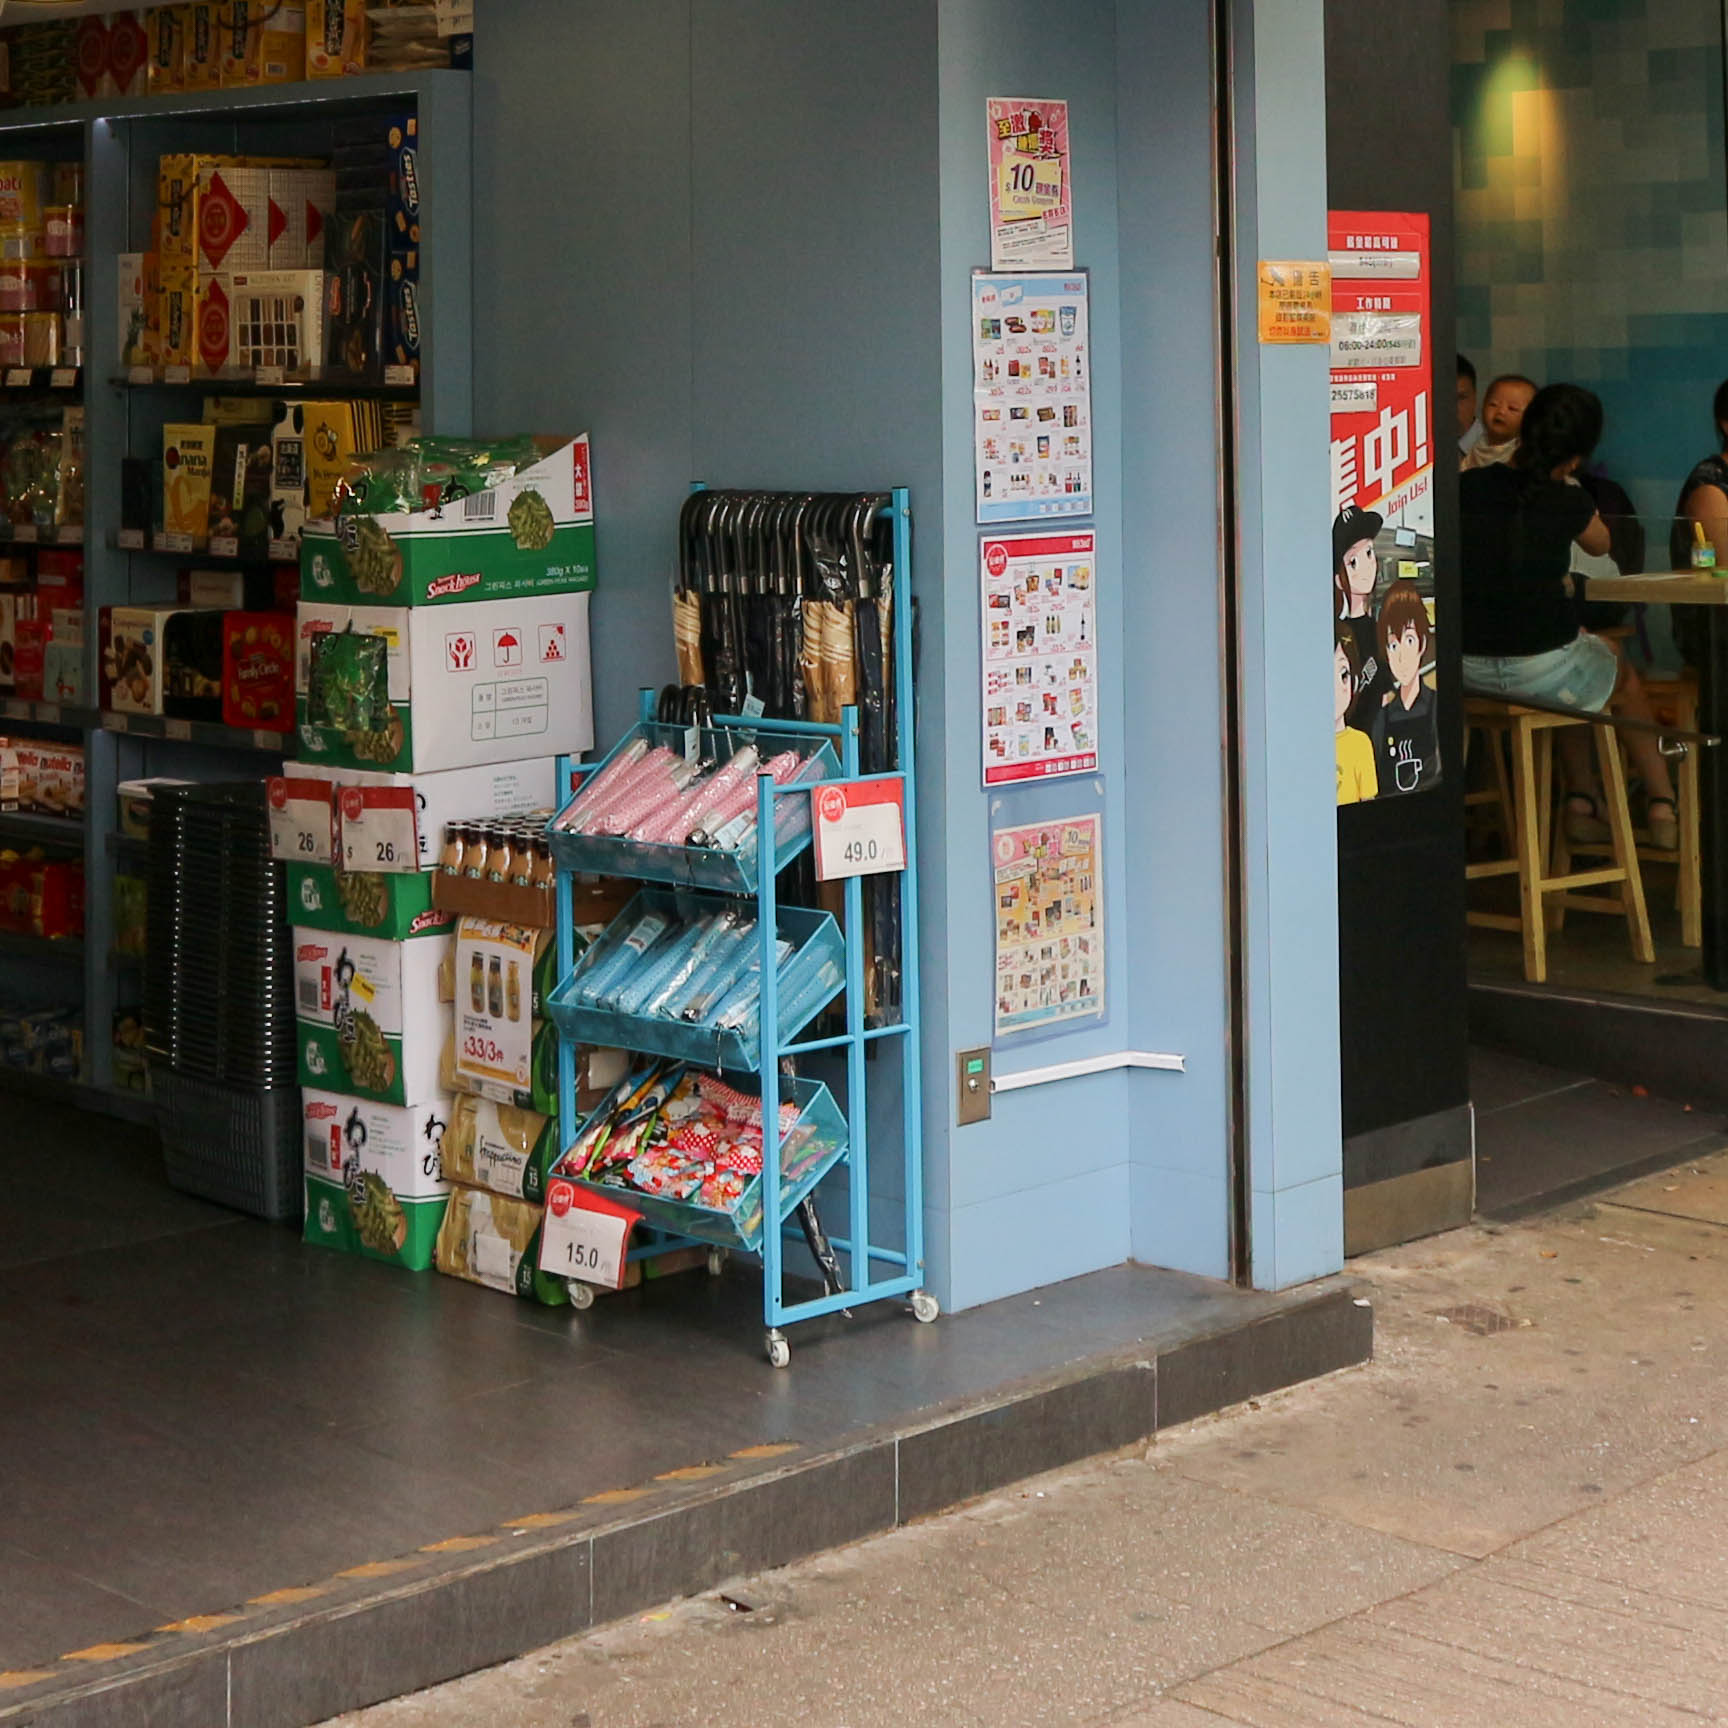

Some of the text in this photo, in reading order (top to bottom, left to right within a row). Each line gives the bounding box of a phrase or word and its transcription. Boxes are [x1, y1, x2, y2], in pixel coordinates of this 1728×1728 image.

[298, 831, 314, 853] 26
[376, 841, 395, 862] 26
[844, 839, 879, 864] 49.0
[566, 1242, 600, 1270] 15.0
